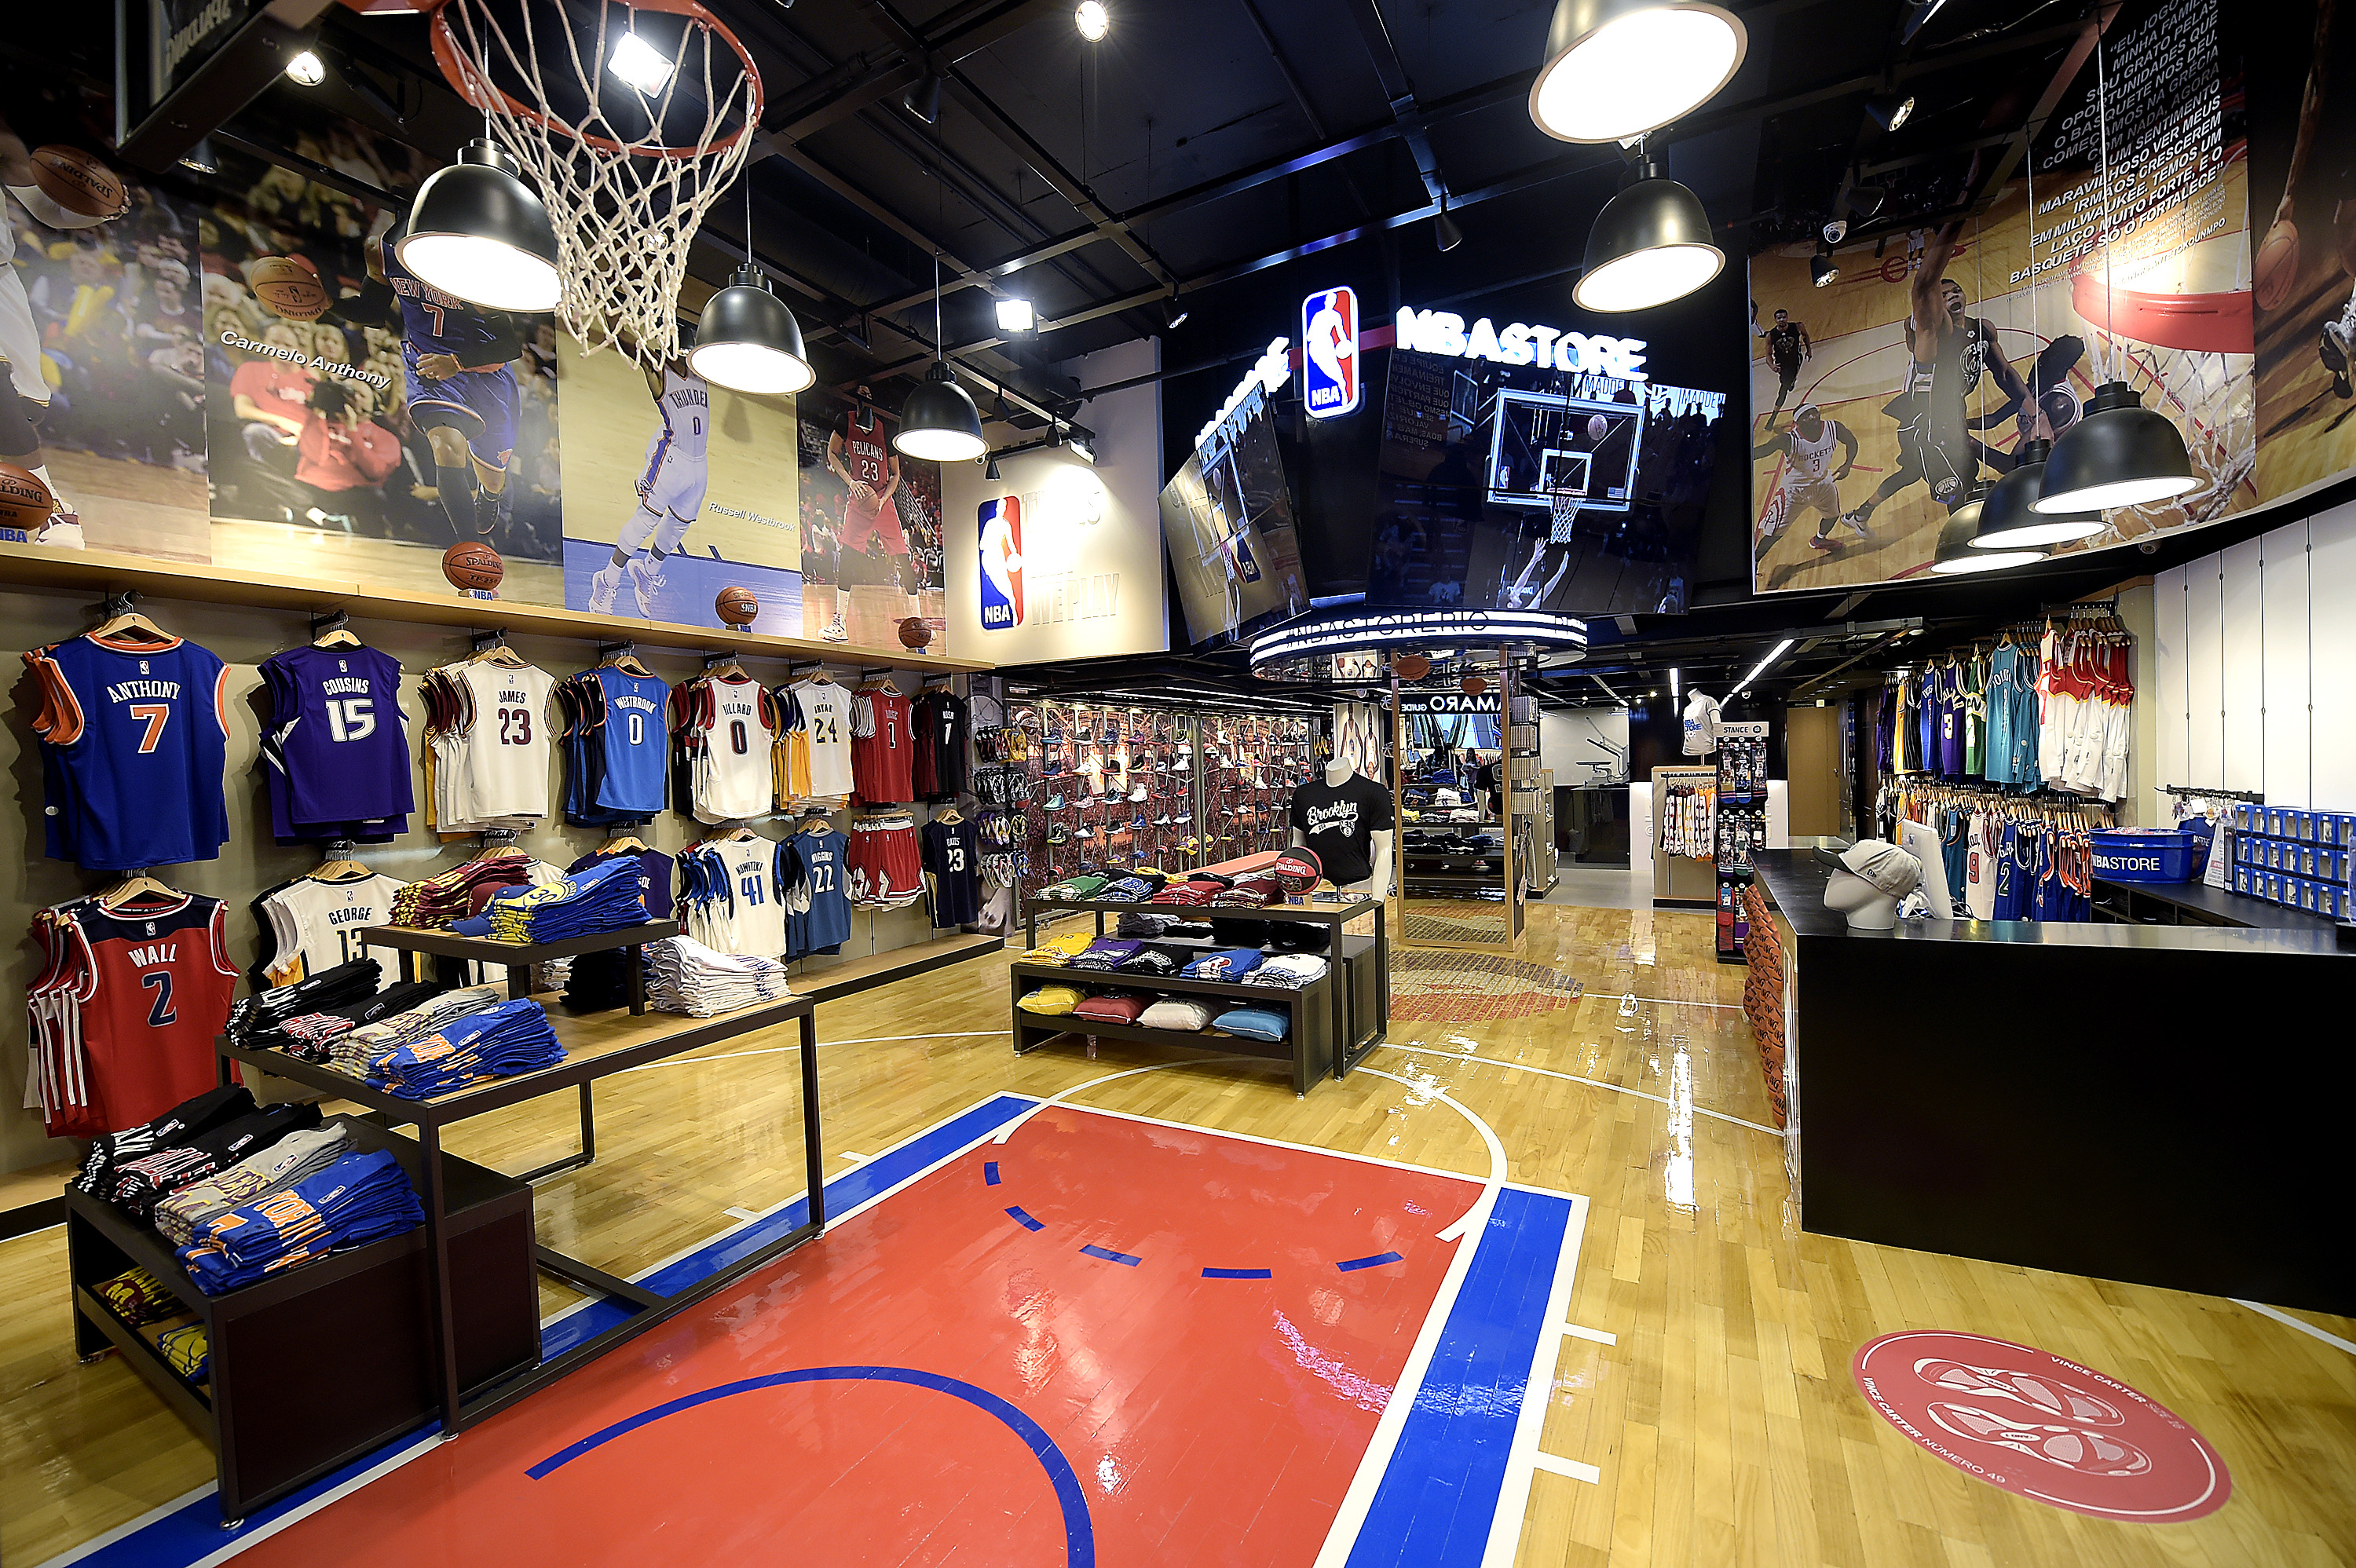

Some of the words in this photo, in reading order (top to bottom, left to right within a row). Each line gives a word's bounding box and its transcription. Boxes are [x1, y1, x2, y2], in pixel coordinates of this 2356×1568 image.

[2140, 0, 2179, 35] JOGO
[2086, 73, 2120, 102] SOU
[2124, 35, 2171, 79] GRATO
[2174, 0, 2218, 42] PELAS
[2113, 30, 2158, 72] MINHA
[2161, 0, 2201, 35] FAMIL
[2062, 38, 2186, 130] OPORTUNIDADES
[2190, 9, 2219, 43] QUE
[2054, 135, 2066, 149] O
[2070, 80, 2153, 142] BASQUETE
[2156, 57, 2184, 89] NOS
[2187, 29, 2219, 64] DEU.
[2127, 104, 2168, 141] NADA,
[2171, 61, 2219, 109] AGORA
[2043, 104, 2144, 170] COMEÇAMOS
[2147, 87, 2165, 111] NA
[2169, 44, 2219, 93] GRÉCIA
[2109, 143, 2132, 166] UM
[2135, 78, 2220, 150] SENTIMENTO
[2038, 147, 2150, 216] MARAVILHOSO
[2153, 126, 2180, 154] VER
[2182, 94, 2221, 134] MEUS
[2073, 172, 2137, 215] IRMÃOS
[2138, 110, 2222, 180] CRESCEREM
[2029, 227, 2054, 248] EM
[2054, 181, 2150, 239] MILWAUKEE.
[2152, 146, 2199, 187] TEMOS
[2201, 127, 2222, 154] UM
[2050, 225, 2096, 254] LAÇO
[2098, 197, 2148, 233] MUITO
[2148, 165, 2196, 207] FORTE,
[2199, 150, 2211, 173] E
[2211, 144, 2223, 163] O
[2008, 239, 2095, 285] BASQUETE
[2096, 225, 2121, 249] SÓ
[421, 283, 464, 310] YORK
[421, 302, 444, 338] 7
[221, 330, 308, 365] Carmelo
[309, 355, 392, 389] Anthony
[1311, 385, 1341, 407] NBA
[692, 415, 702, 437] 0
[852, 440, 884, 462] PELICANS
[1798, 444, 1833, 462] ROCKETS
[1813, 459, 1821, 473] 3
[861, 459, 879, 482] 23
[0, 484, 44, 504] LDING
[708, 502, 747, 520] Russell
[748, 511, 796, 532] Westbrook
[474, 590, 493, 601] NBA
[984, 604, 1012, 624] NBA
[106, 680, 181, 704] ANTHONY
[322, 677, 370, 696] COUSINS
[498, 689, 527, 705] JAMES
[325, 698, 377, 743] 15
[614, 696, 657, 715] WESTBROOK
[129, 703, 170, 754] 7
[497, 707, 532, 746] 23
[627, 712, 644, 747] 0
[730, 719, 748, 756] 0
[814, 717, 839, 744] 24
[887, 722, 897, 749] 1
[1723, 726, 1749, 734] STANCE
[1307, 799, 1359, 826] Brooklyn
[735, 861, 764, 876] NOWITZKI
[812, 864, 835, 894] 22
[1275, 861, 1307, 876] SPALDING
[741, 874, 765, 907] 41
[1289, 895, 1305, 906] NBA
[327, 907, 373, 925] GEORGE
[127, 943, 177, 968] WALL
[336, 927, 368, 963] 13
[141, 970, 177, 1028] 2
[2051, 1355, 2092, 1377] VINCE
[2093, 1374, 2147, 1404] CARTER
[1862, 1376, 1885, 1402] VINCE
[1877, 1400, 1923, 1439] CARTER
[1921, 1436, 1985, 1475] NÚMERO
[1985, 1471, 2007, 1484] 49
